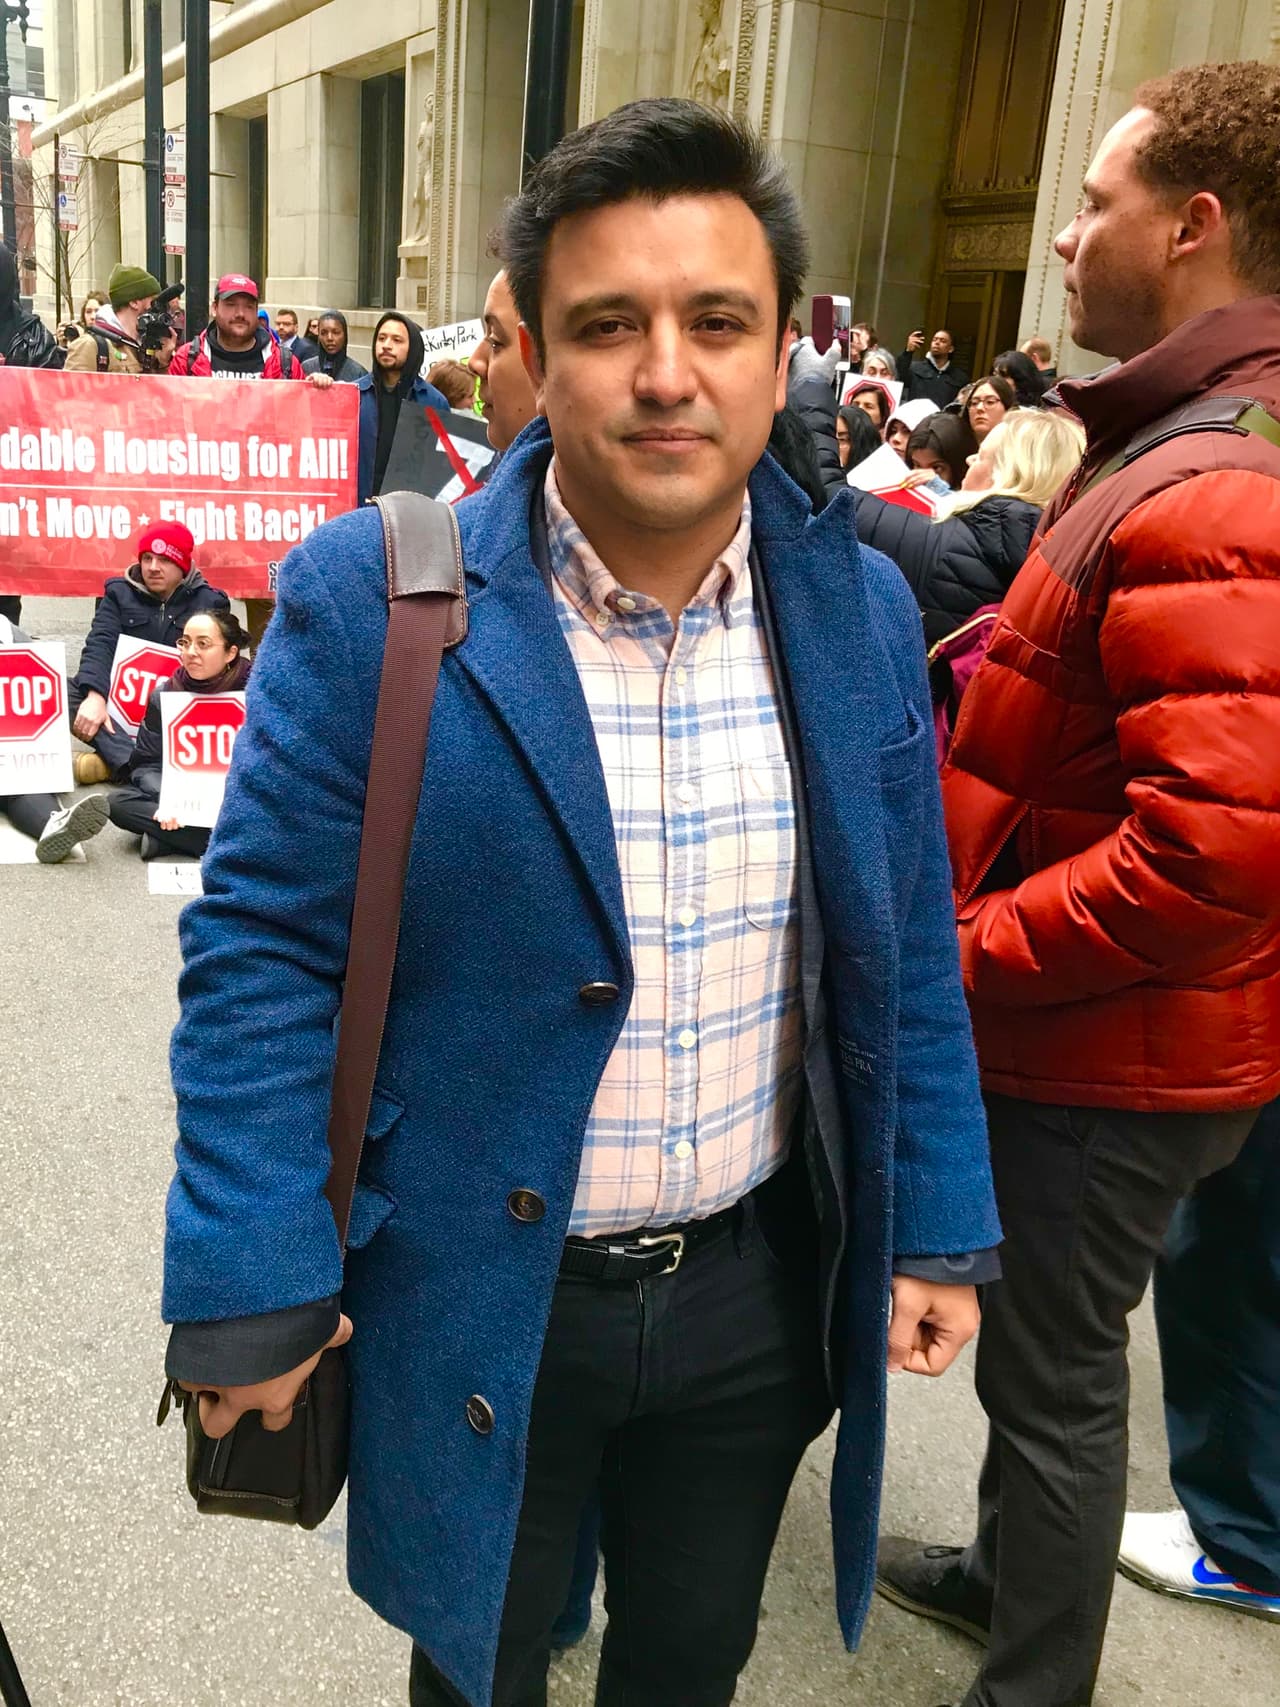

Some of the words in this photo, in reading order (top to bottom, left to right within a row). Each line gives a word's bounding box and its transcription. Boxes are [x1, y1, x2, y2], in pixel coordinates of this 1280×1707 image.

[457, 326, 477, 345] Park
[0, 426, 96, 473] dable
[103, 430, 240, 482] Housing
[247, 435, 292, 478] for
[299, 437, 348, 479] All!
[45, 497, 131, 540] Move
[160, 500, 238, 545] Fight
[178, 724, 243, 766] STO
